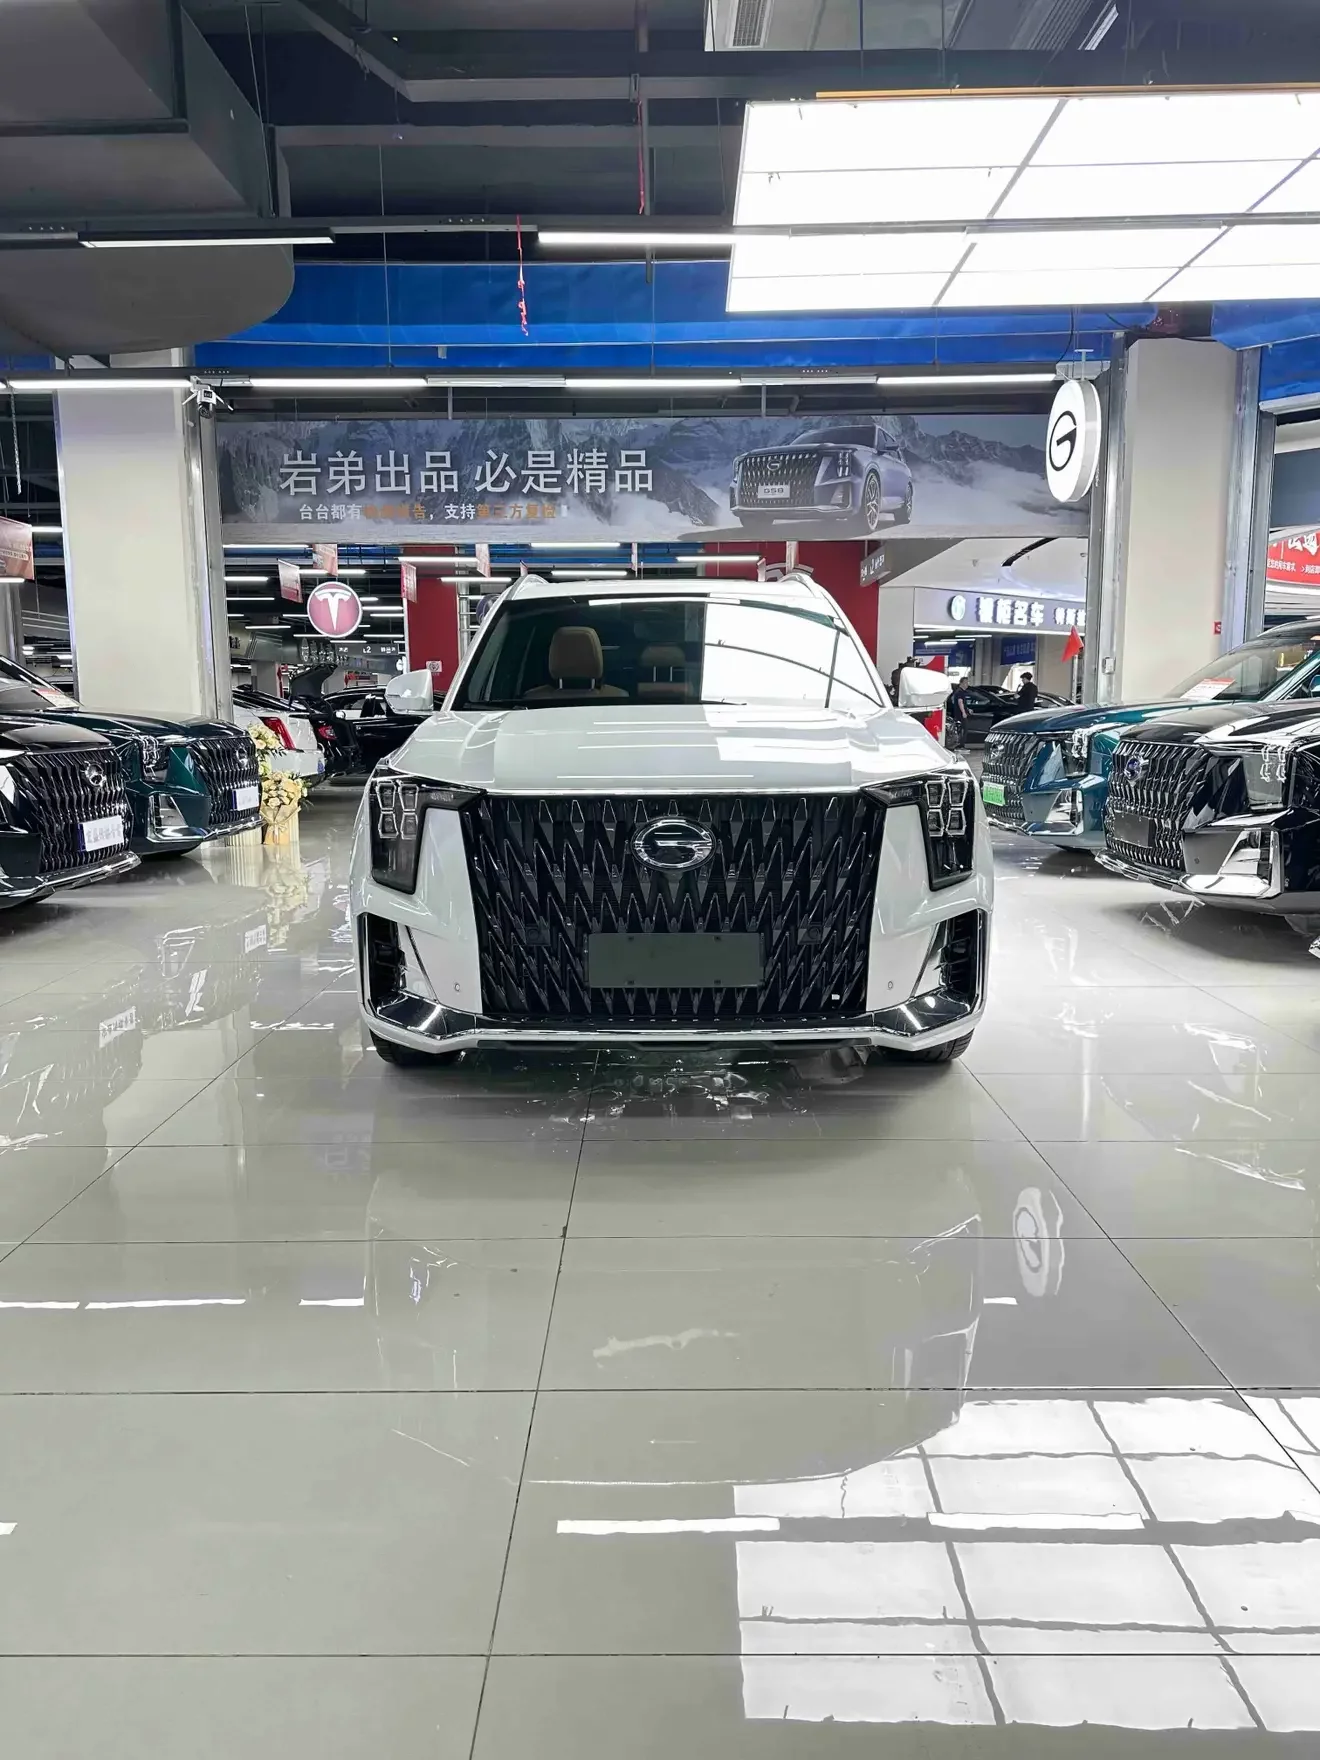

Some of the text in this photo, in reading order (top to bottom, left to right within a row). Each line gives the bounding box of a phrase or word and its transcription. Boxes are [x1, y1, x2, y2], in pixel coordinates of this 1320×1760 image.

[279, 448, 653, 495] 岩弟出品 必是精品
